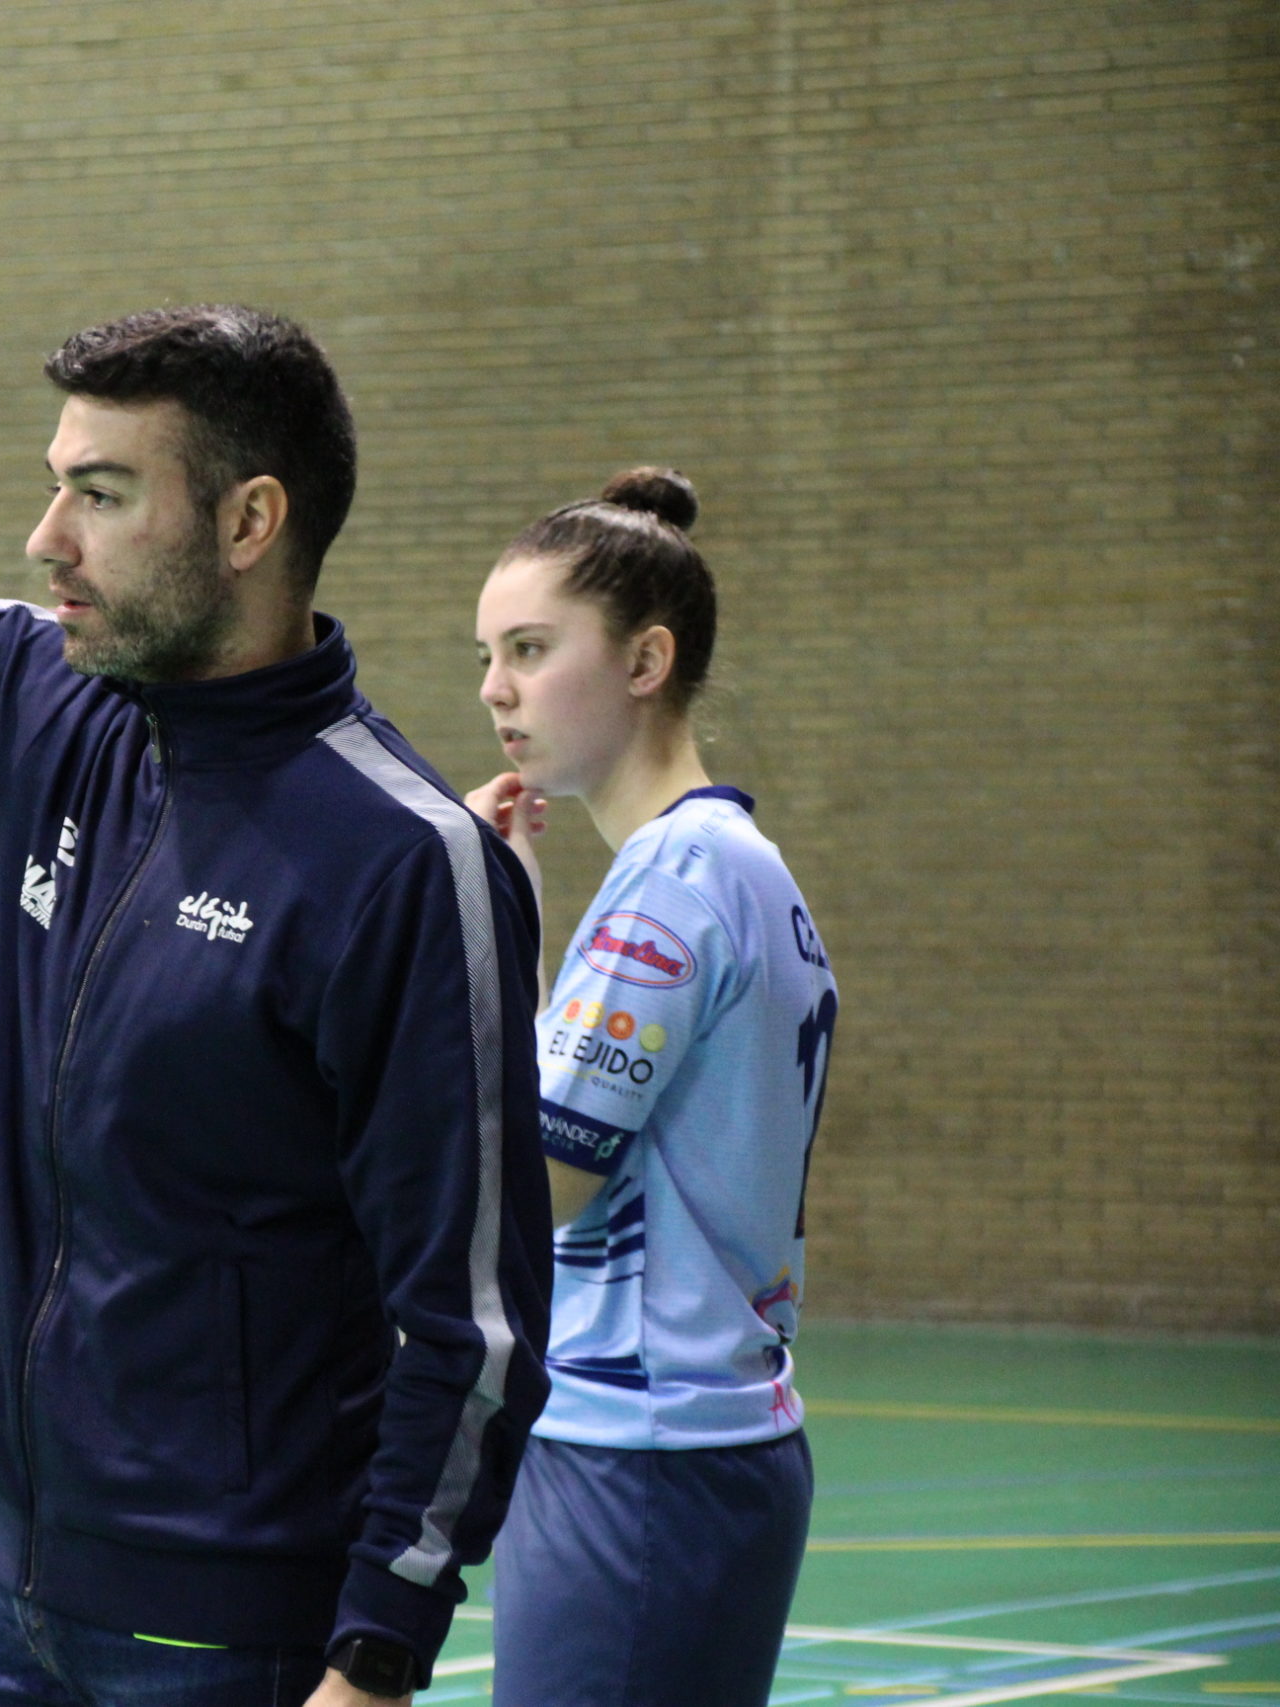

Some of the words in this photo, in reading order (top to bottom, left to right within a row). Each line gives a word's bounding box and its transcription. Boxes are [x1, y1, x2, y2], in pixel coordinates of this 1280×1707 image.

[549, 1030, 569, 1056] EL
[573, 1035, 654, 1085] EJIDO
[591, 1076, 643, 1099] QUALITY
